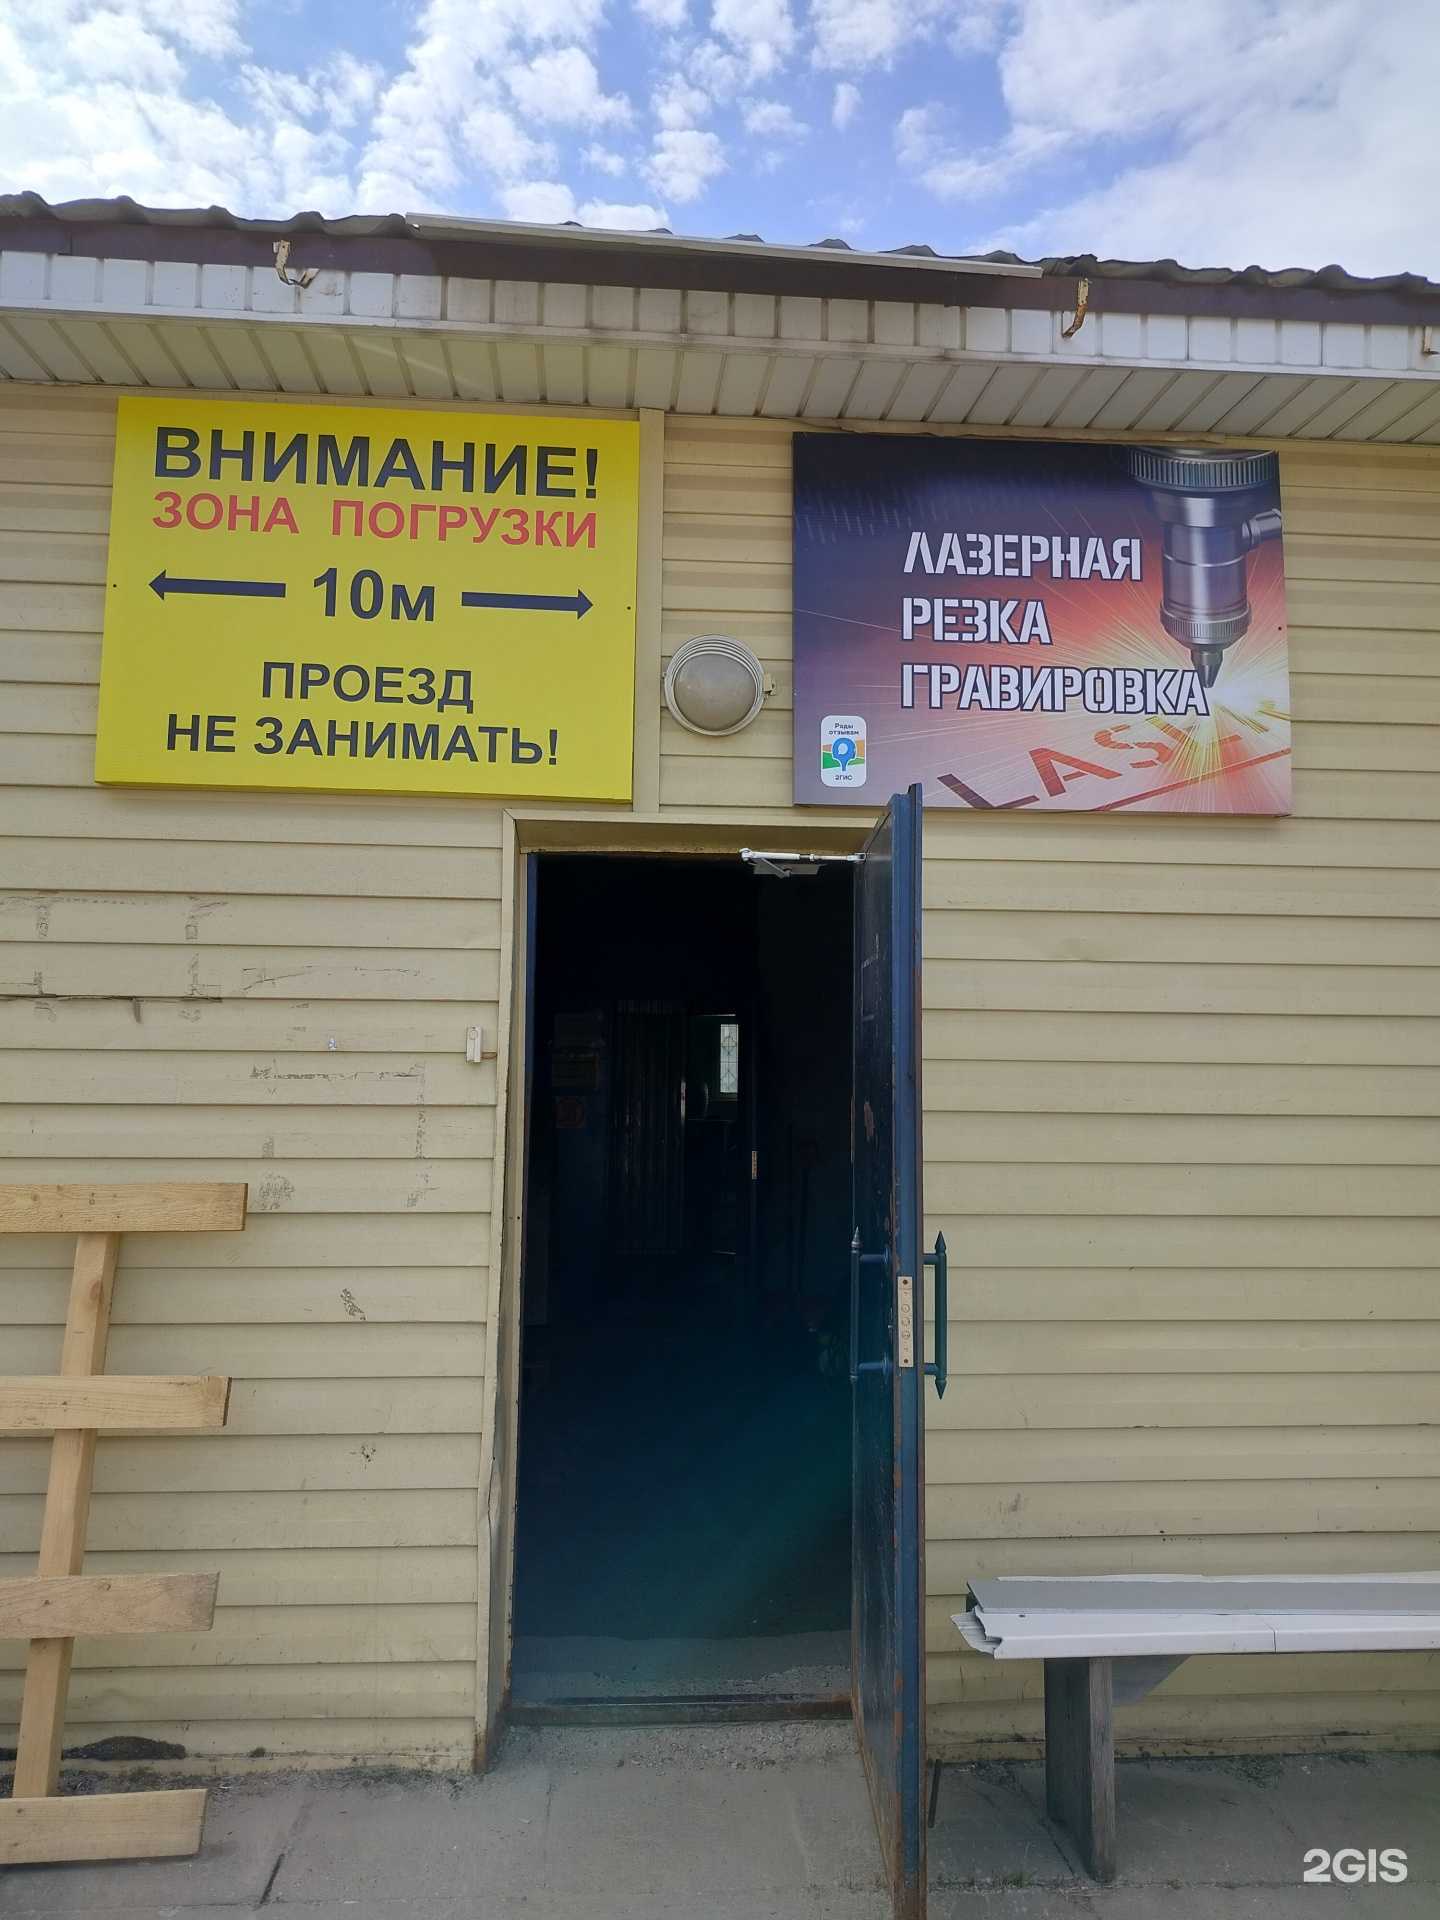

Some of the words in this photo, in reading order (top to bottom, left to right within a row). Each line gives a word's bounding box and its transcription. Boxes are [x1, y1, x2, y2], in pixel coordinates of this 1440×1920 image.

[154, 426, 598, 498] ВНИМАНИЕ!
[152, 491, 300, 534] ЗОНА
[331, 499, 597, 548] ПОГРУЗКИ
[902, 530, 1143, 581] ЛАЗЕРНАЯ
[312, 567, 435, 622] 10м
[901, 597, 1053, 645] РЕЗКА
[261, 661, 474, 714] ПРОЕЗД
[901, 663, 1210, 716] ГРАВИРОВКА
[166, 713, 237, 753] НЕ
[253, 716, 558, 766] ЗАНИМАТЬ!
[834, 722, 854, 730] Рады
